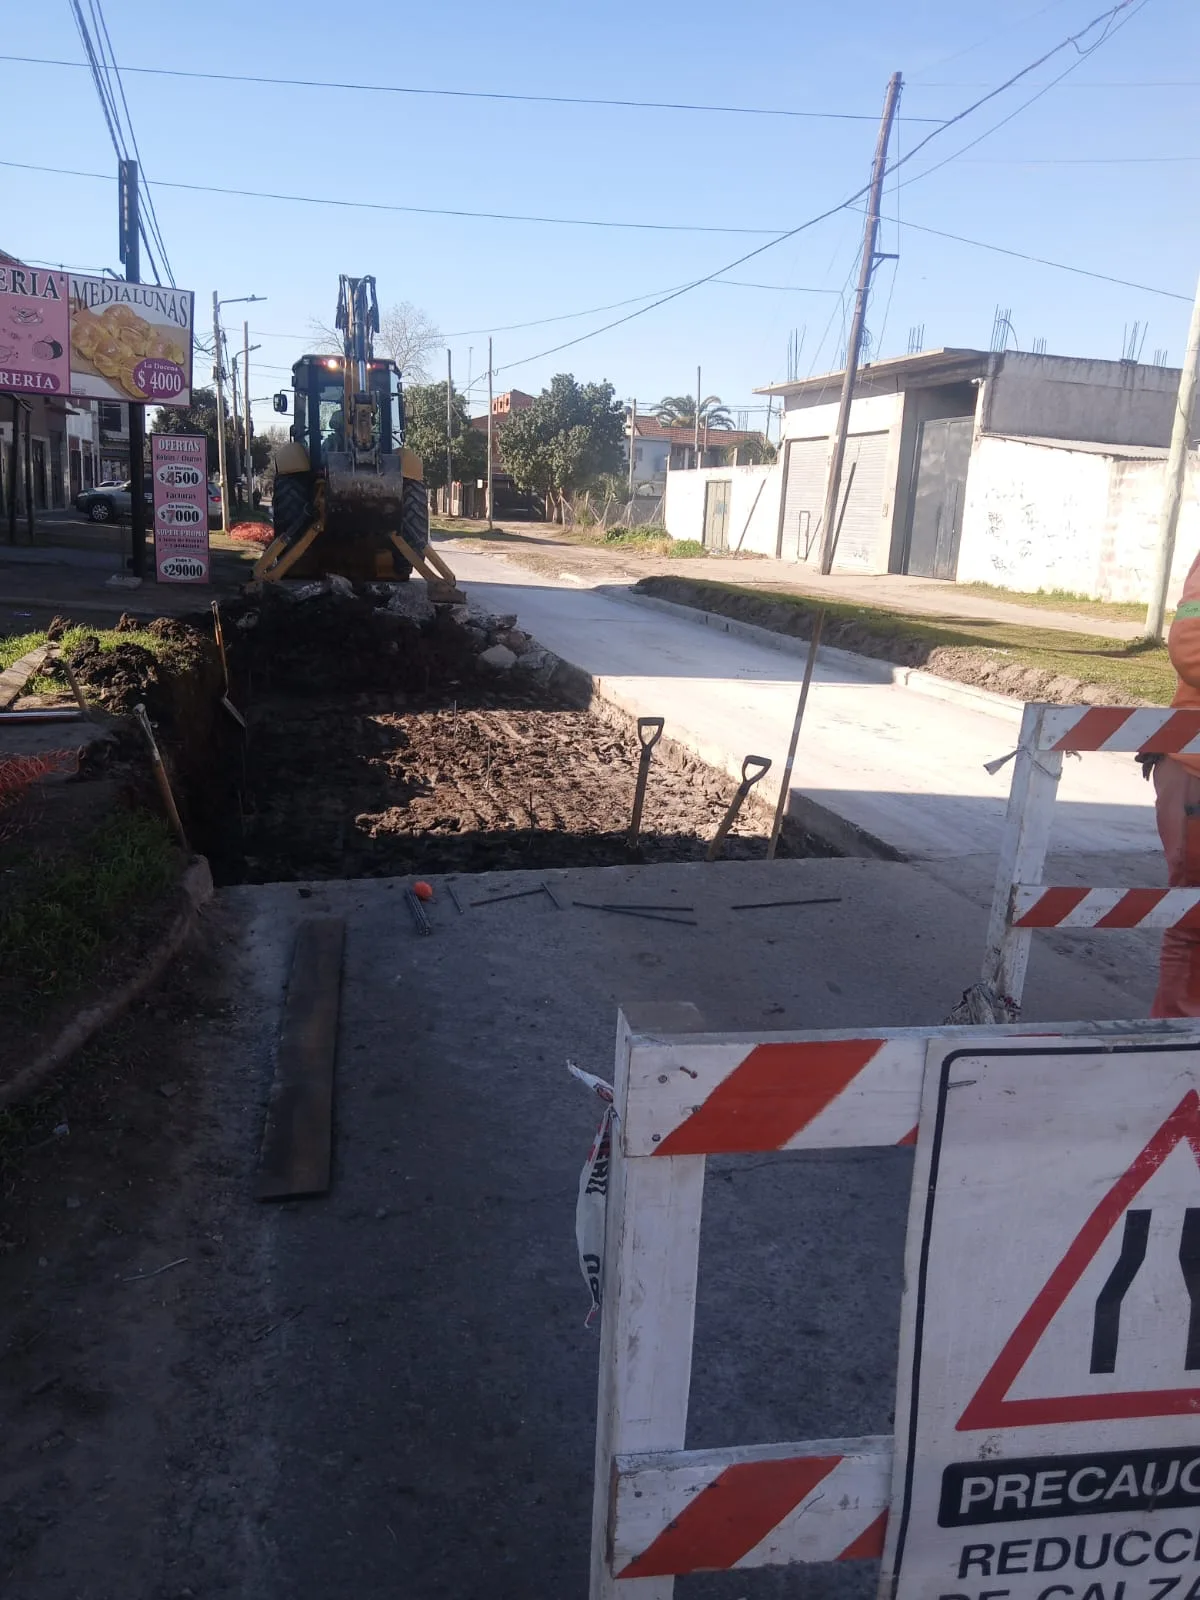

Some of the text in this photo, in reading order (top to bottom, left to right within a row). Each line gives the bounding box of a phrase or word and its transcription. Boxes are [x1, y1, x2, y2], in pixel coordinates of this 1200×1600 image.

[73, 279, 188, 328] MEDIALUNAS
[138, 368, 181, 393] $ 4000
[158, 438, 201, 452] OFERTAS
